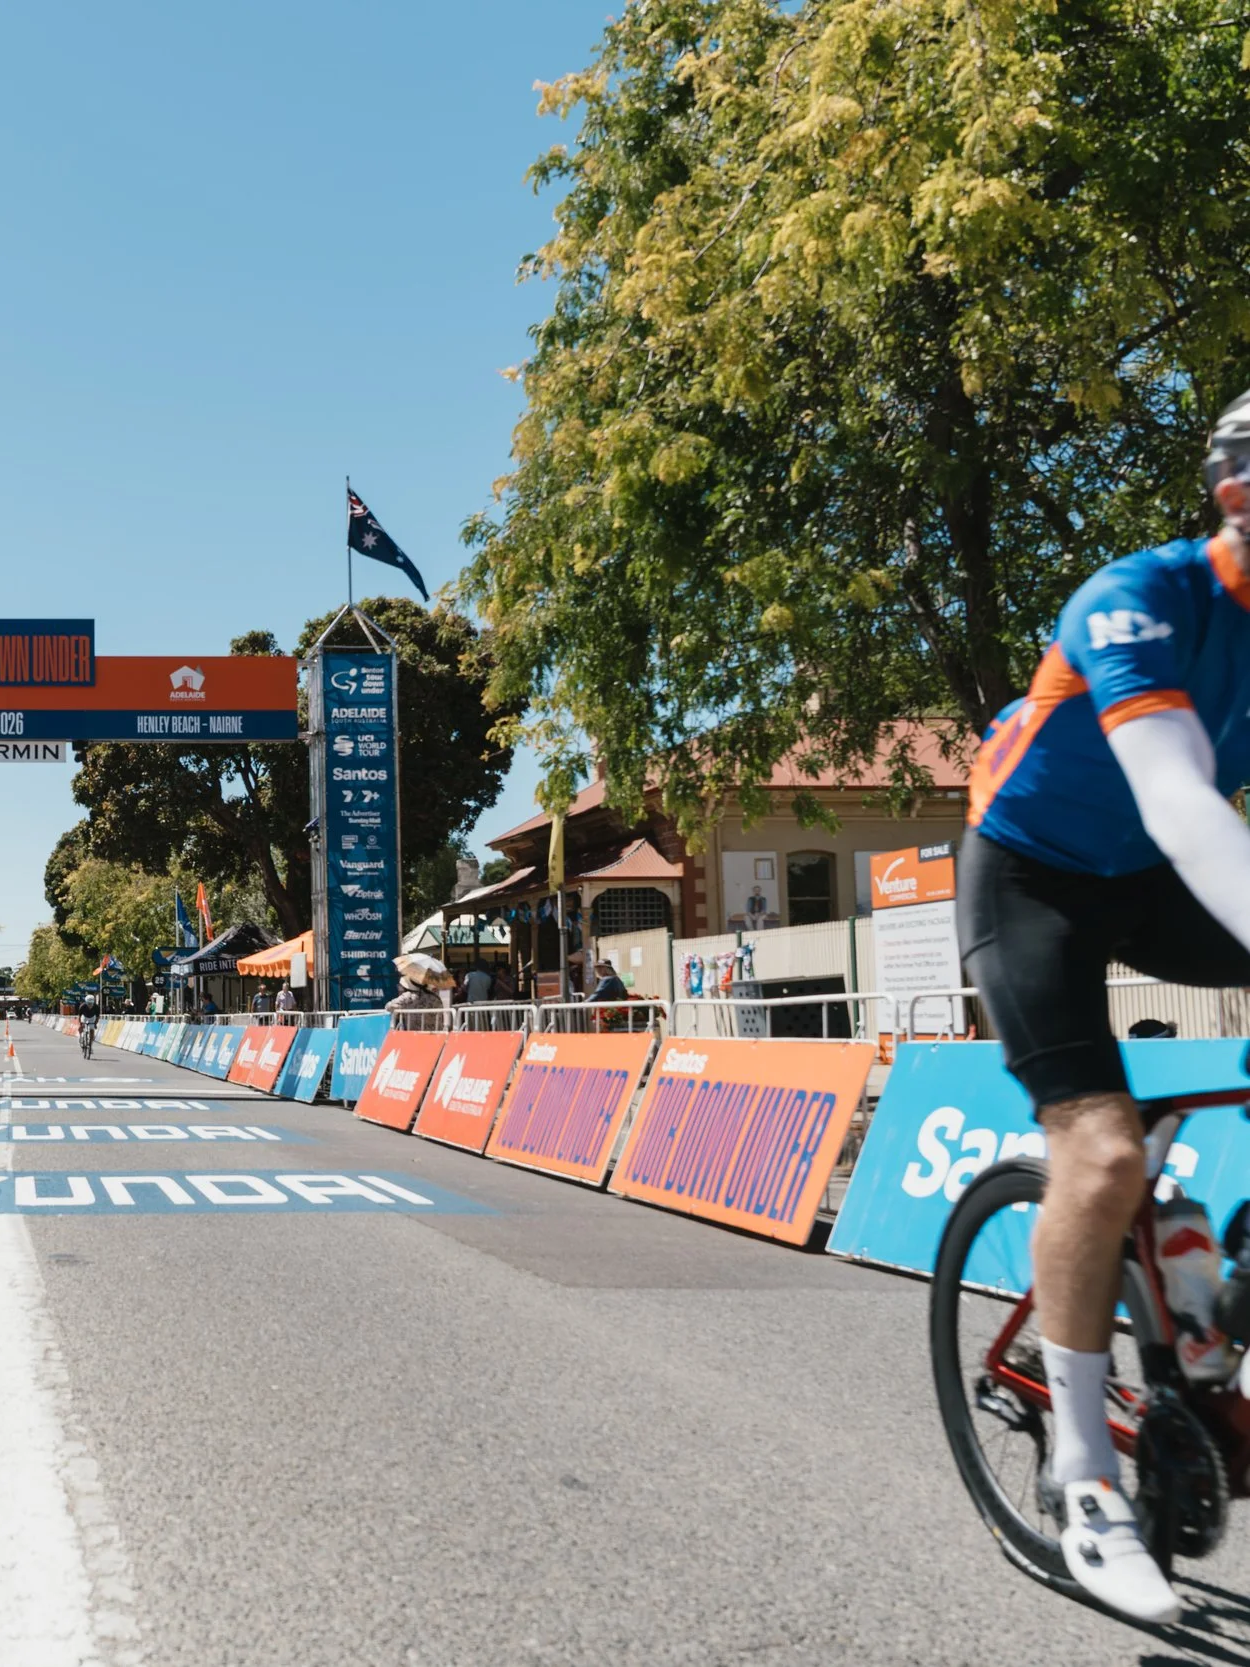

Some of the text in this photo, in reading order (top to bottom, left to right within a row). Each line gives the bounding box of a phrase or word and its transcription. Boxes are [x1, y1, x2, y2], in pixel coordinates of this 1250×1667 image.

[32, 635, 90, 682] UNDER
[331, 708, 387, 718] ADELAIDE
[137, 716, 170, 733] HENLEY
[172, 716, 200, 733] BEACH
[209, 716, 243, 733] NAIRNE
[332, 767, 387, 780] Santos
[920, 844, 950, 858] FOR SALE
[340, 859, 384, 871] Vanguard
[874, 857, 918, 895] Venture
[355, 889, 384, 899] Ziptrak
[343, 930, 383, 940] Santini
[200, 961, 217, 971] RIDE
[354, 988, 384, 997] YAMAHA
[340, 1041, 378, 1076] Santos
[526, 1042, 558, 1062] Santos
[662, 1048, 708, 1074] Santos
[387, 1068, 420, 1092] ADELAIDE
[453, 1077, 494, 1104] ADELAIDE
[625, 1076, 837, 1225] TOUR DOWN UNDER
